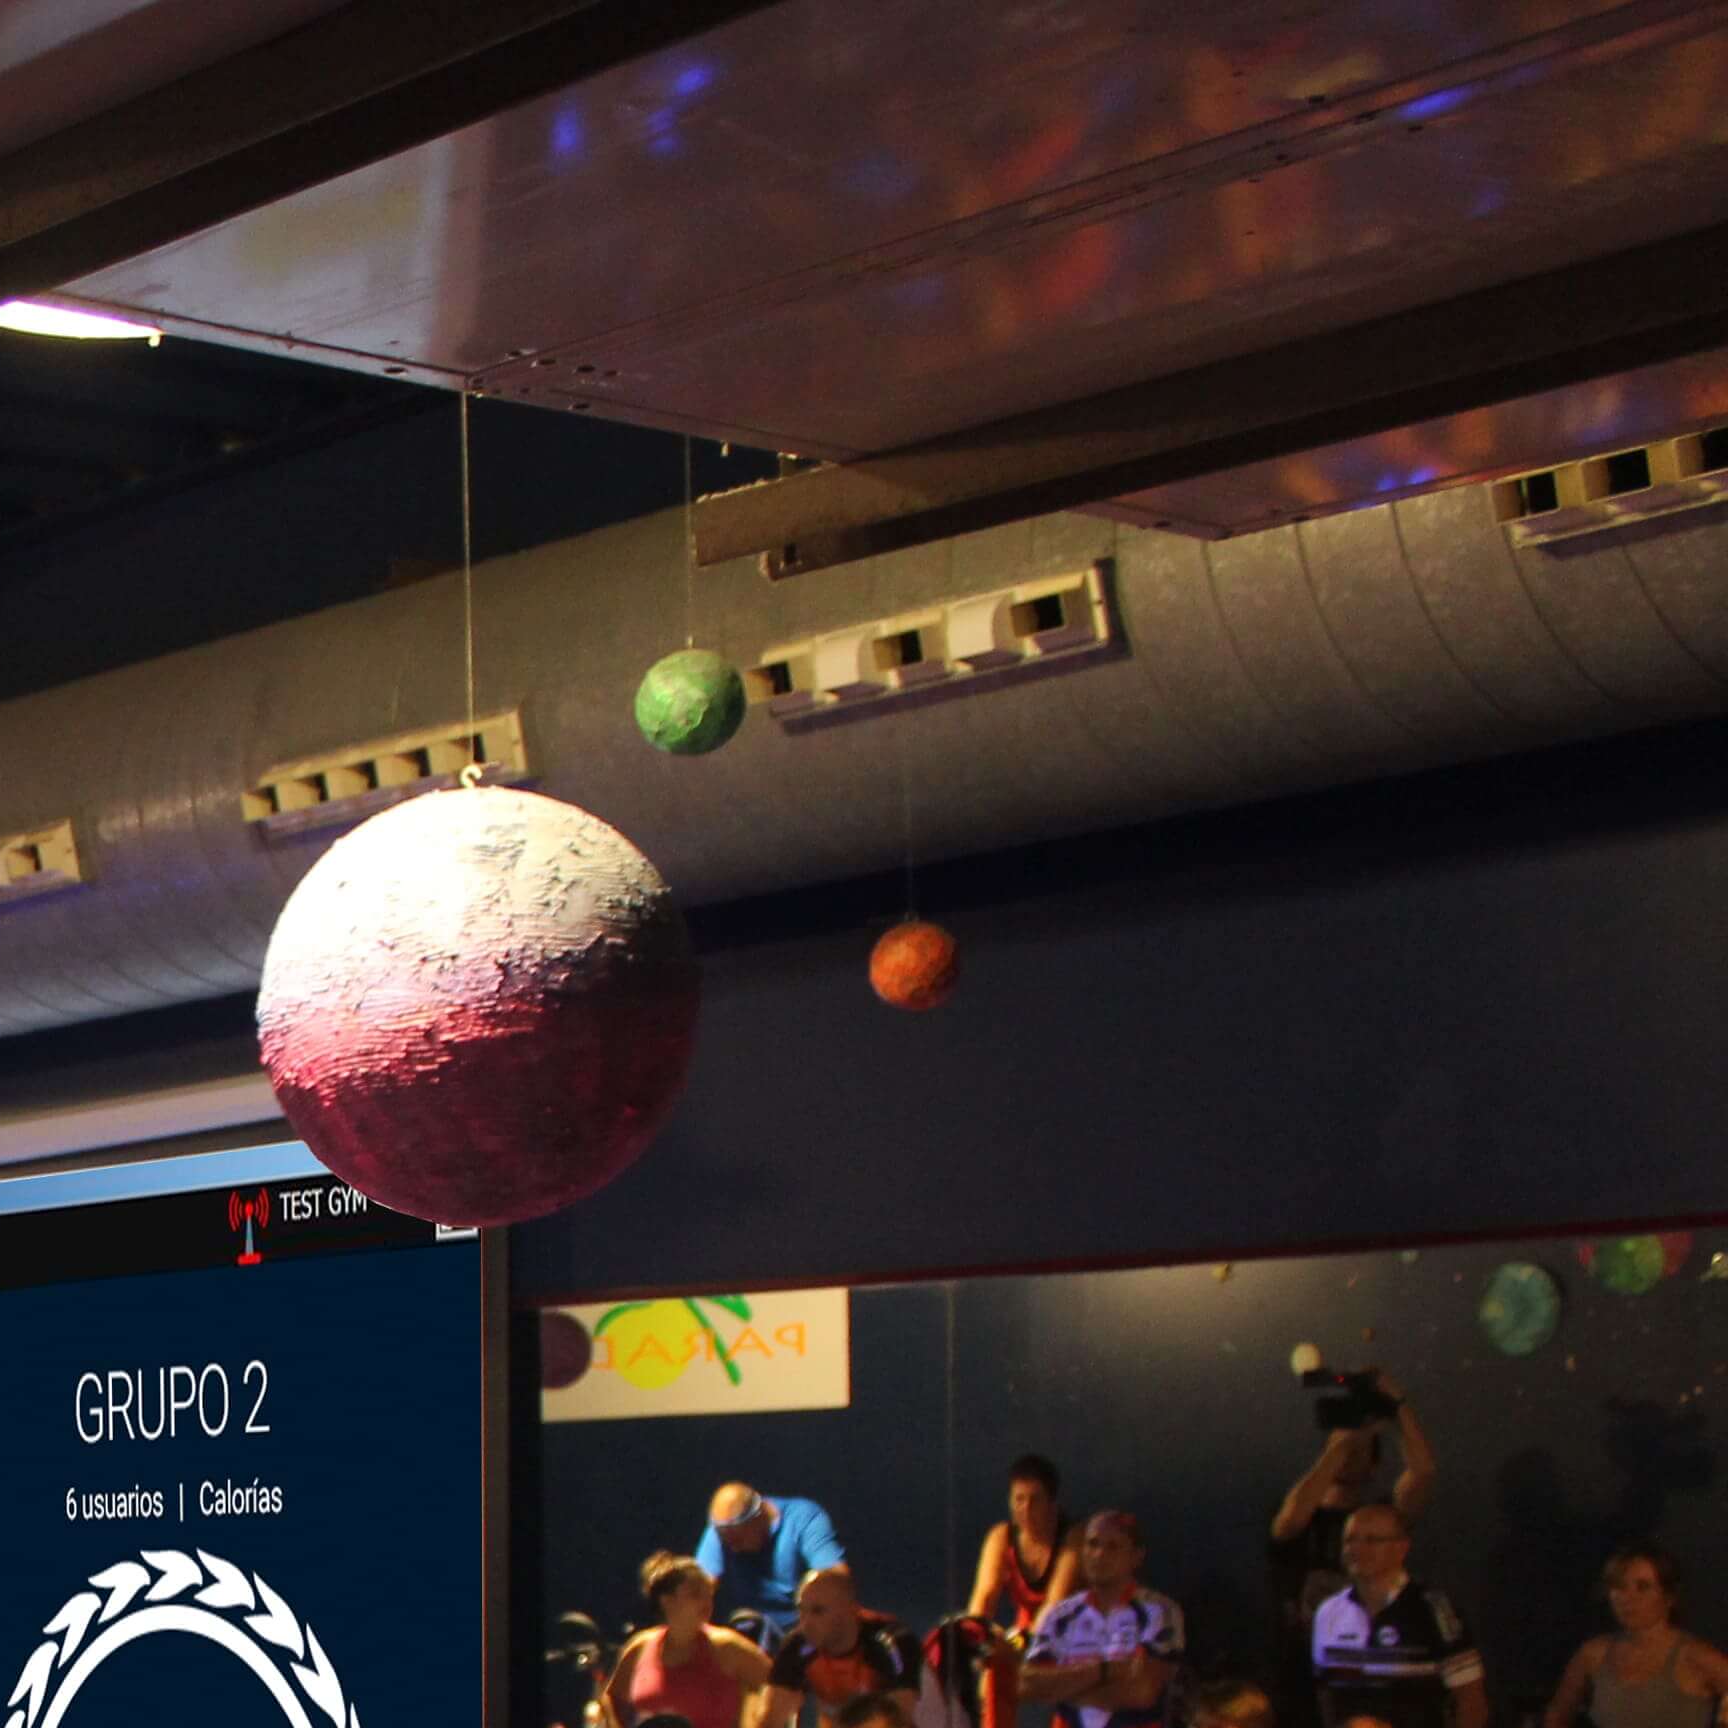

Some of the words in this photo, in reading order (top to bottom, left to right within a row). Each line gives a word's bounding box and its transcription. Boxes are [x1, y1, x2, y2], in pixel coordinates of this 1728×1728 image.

[279, 1187, 323, 1222] TEST
[327, 1184, 368, 1217] GYM
[75, 1363, 229, 1444] GRUPO
[243, 1359, 271, 1433] 2
[66, 1487, 78, 1521] 6
[82, 1484, 164, 1520] usuarios
[199, 1477, 283, 1516] Calorías
